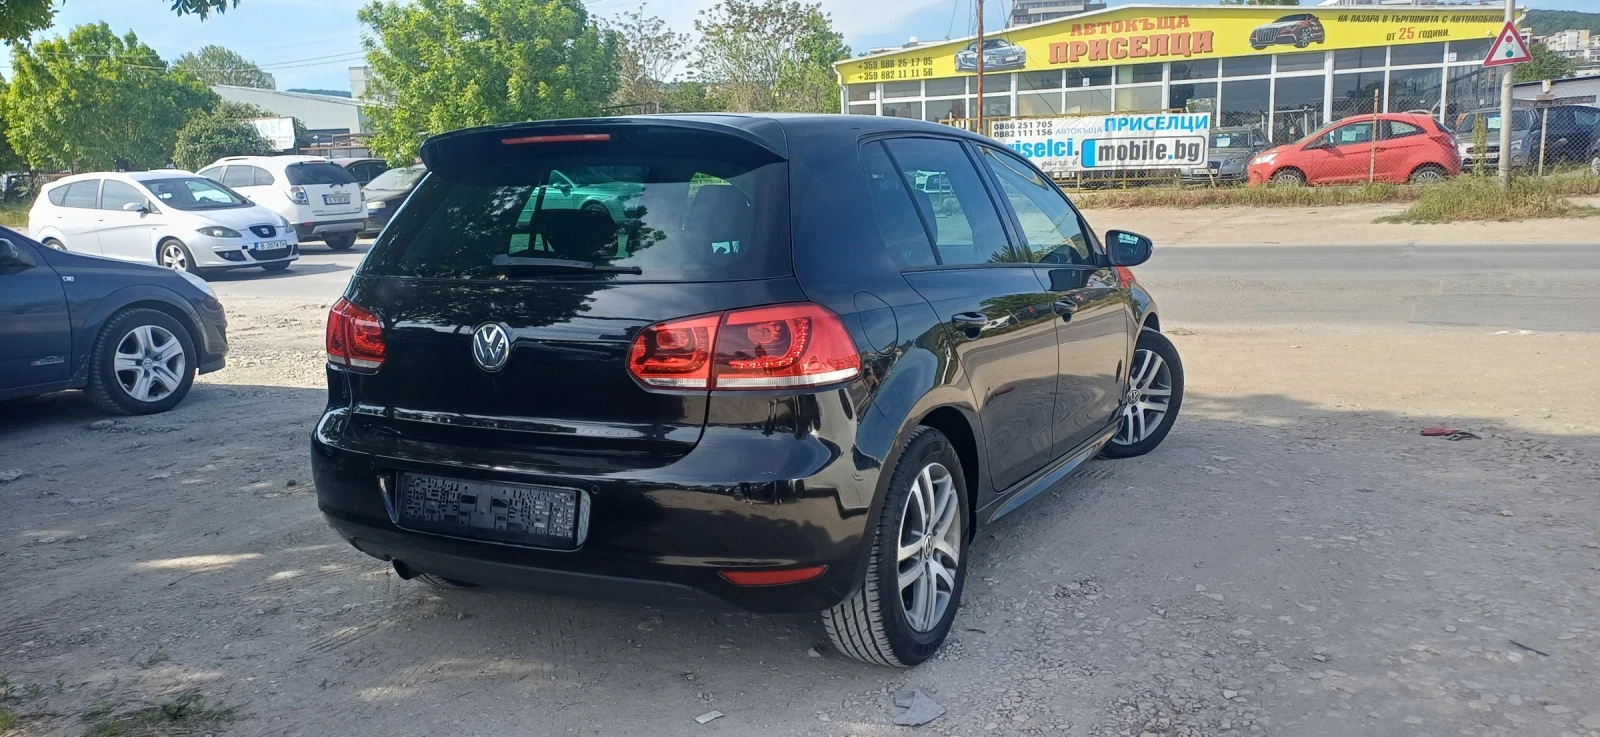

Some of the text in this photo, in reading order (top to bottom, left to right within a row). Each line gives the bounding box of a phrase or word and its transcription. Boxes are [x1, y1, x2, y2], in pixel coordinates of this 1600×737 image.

[1337, 14, 1348, 23] НА
[1350, 14, 1379, 23] ПАЗАРА
[1382, 14, 1388, 23] В
[1392, 14, 1439, 24] ТЪРГОВИЯТА
[1442, 14, 1448, 23] С
[1070, 15, 1190, 37] АВТОКЪЩА
[1398, 27, 1415, 40] 25
[1418, 29, 1450, 39] ГОДИНИ.
[1048, 30, 1214, 64] ПРИСЕЛЦИ
[858, 57, 933, 69] +359 886 25 17 05
[858, 67, 933, 80] +359 882 11 11 56
[993, 122, 1016, 131] 0886
[1017, 121, 1034, 129] 251
[1055, 126, 1103, 135] АВТОКЪЩА
[1104, 115, 1209, 133] ПРИСЕЛЦИ
[993, 130, 1016, 138] 0882
[1098, 140, 1200, 162] mobile.bg
